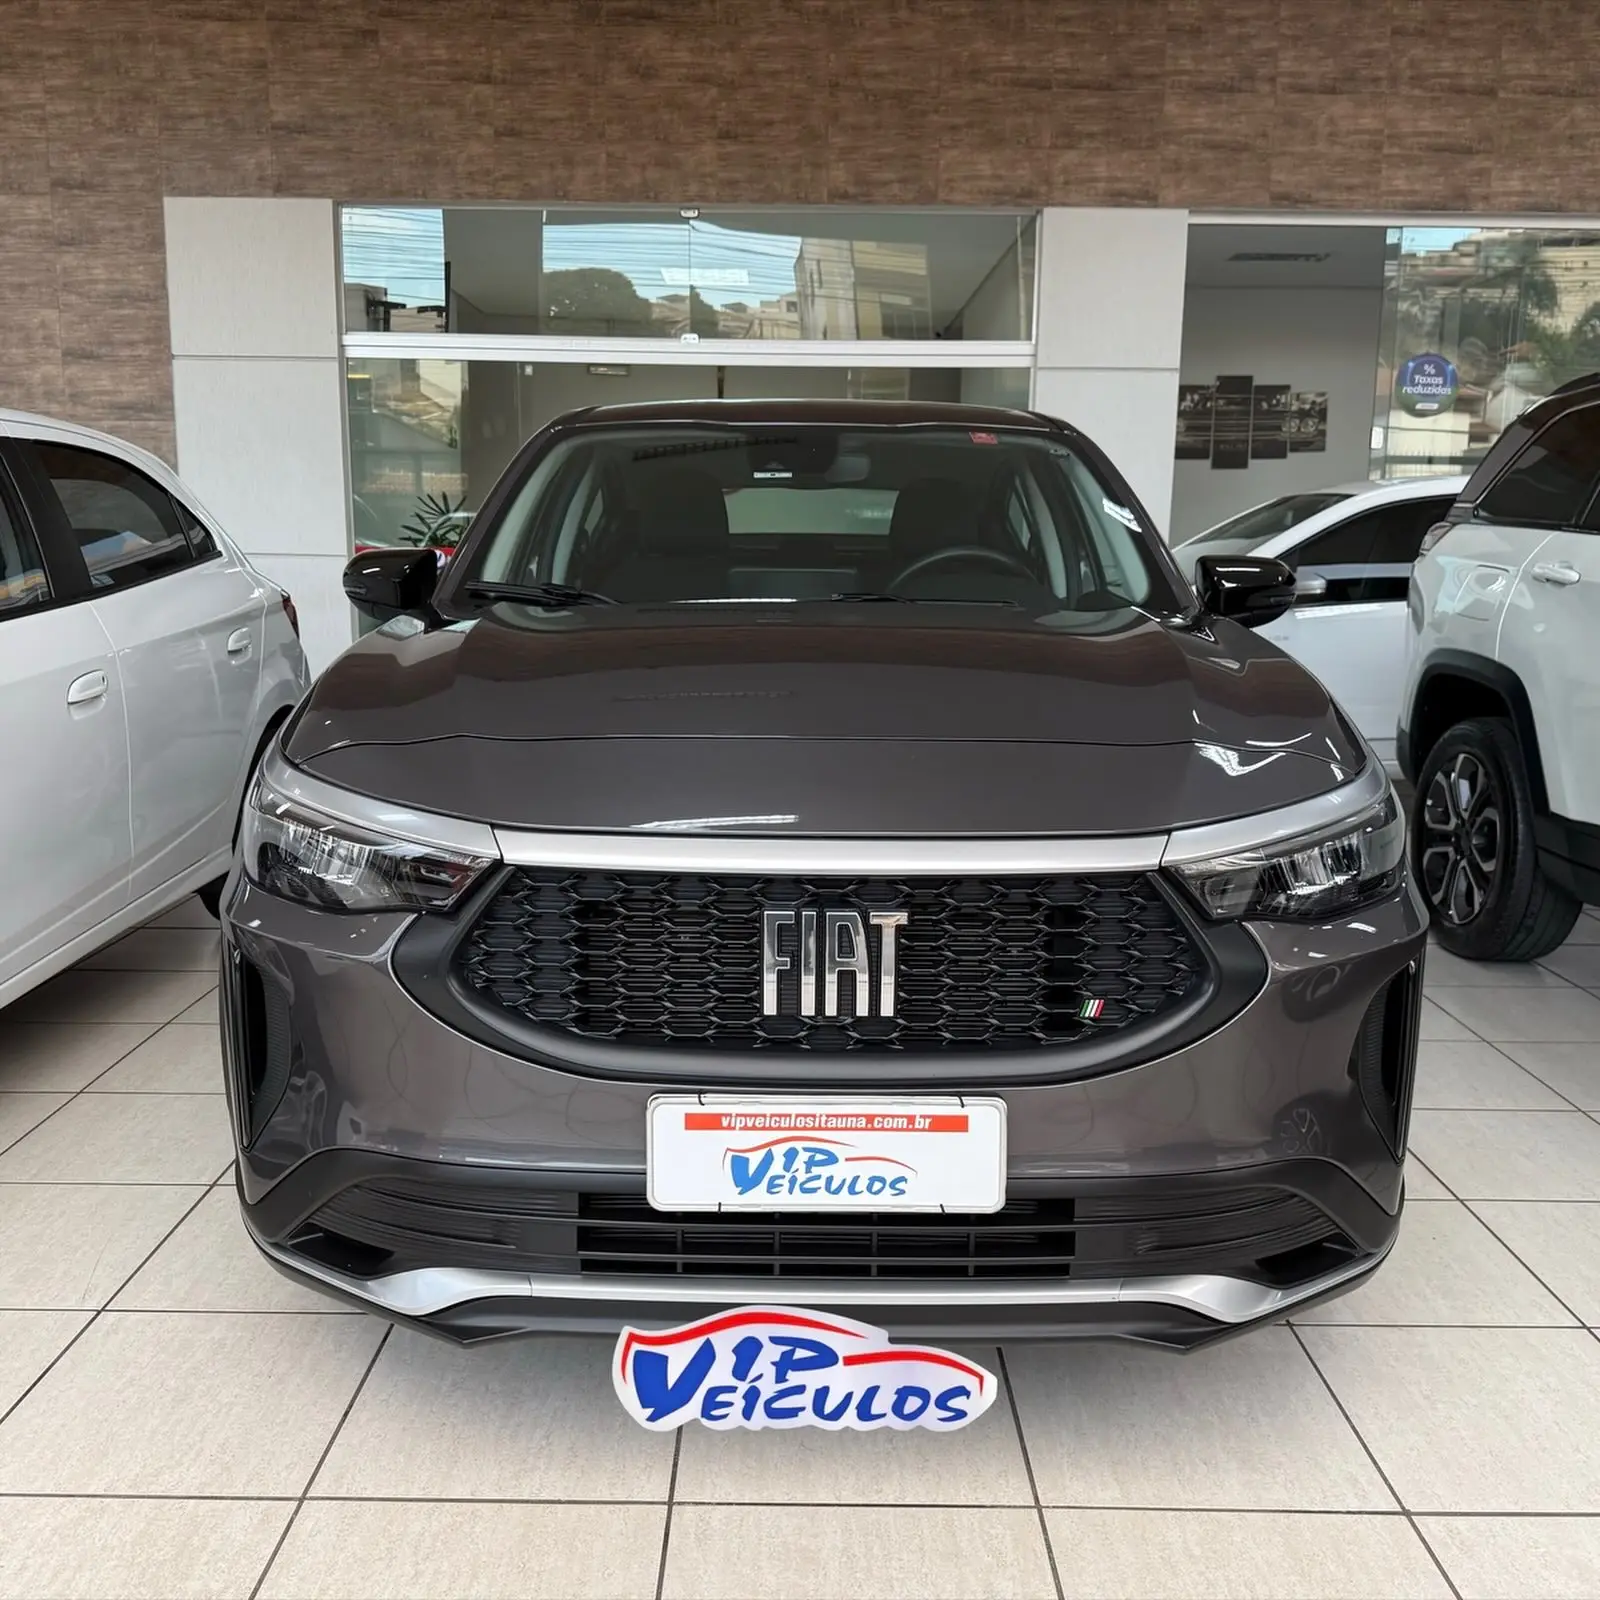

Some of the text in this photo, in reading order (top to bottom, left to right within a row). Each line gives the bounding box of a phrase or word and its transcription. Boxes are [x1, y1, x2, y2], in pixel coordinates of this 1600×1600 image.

[1413, 374, 1444, 384] Taxas
[1402, 385, 1452, 395] reduzidas
[763, 910, 909, 1017] FIAT
[721, 1114, 933, 1130] vipveiculositauna.com.br
